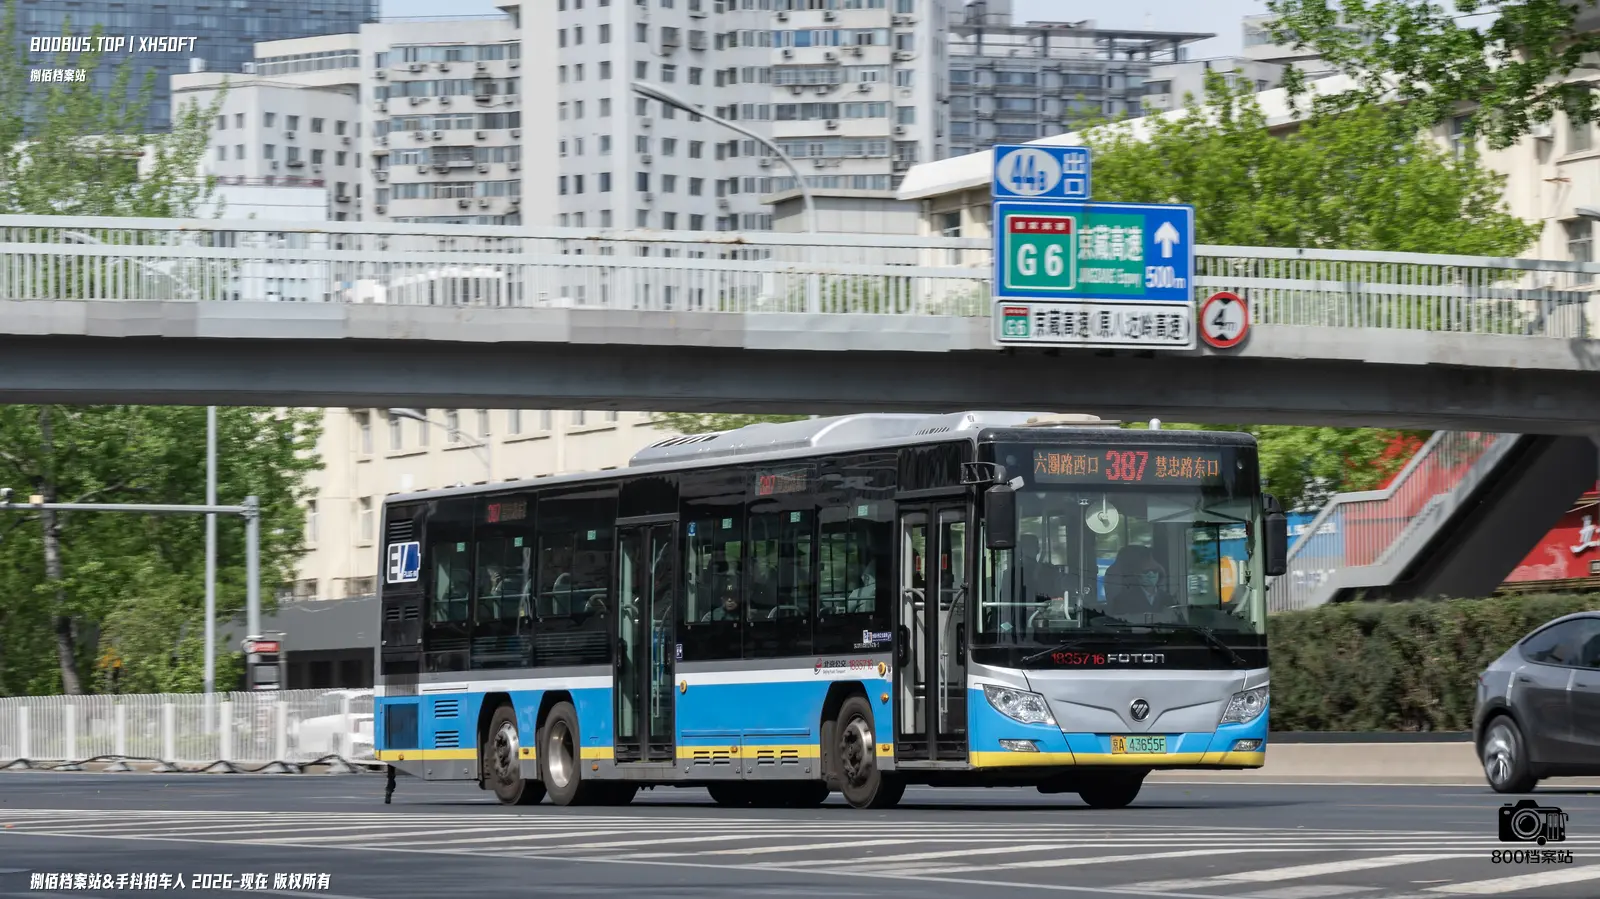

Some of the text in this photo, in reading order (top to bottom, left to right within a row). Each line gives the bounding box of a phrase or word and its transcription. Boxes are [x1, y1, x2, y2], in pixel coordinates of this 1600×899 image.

[1062, 151, 1085, 195] 出口
[1105, 450, 1148, 481] 387
[1155, 455, 1218, 479] 慧忠路东口
[1051, 652, 1105, 665] 1835716
[1107, 653, 1165, 664] FOTON
